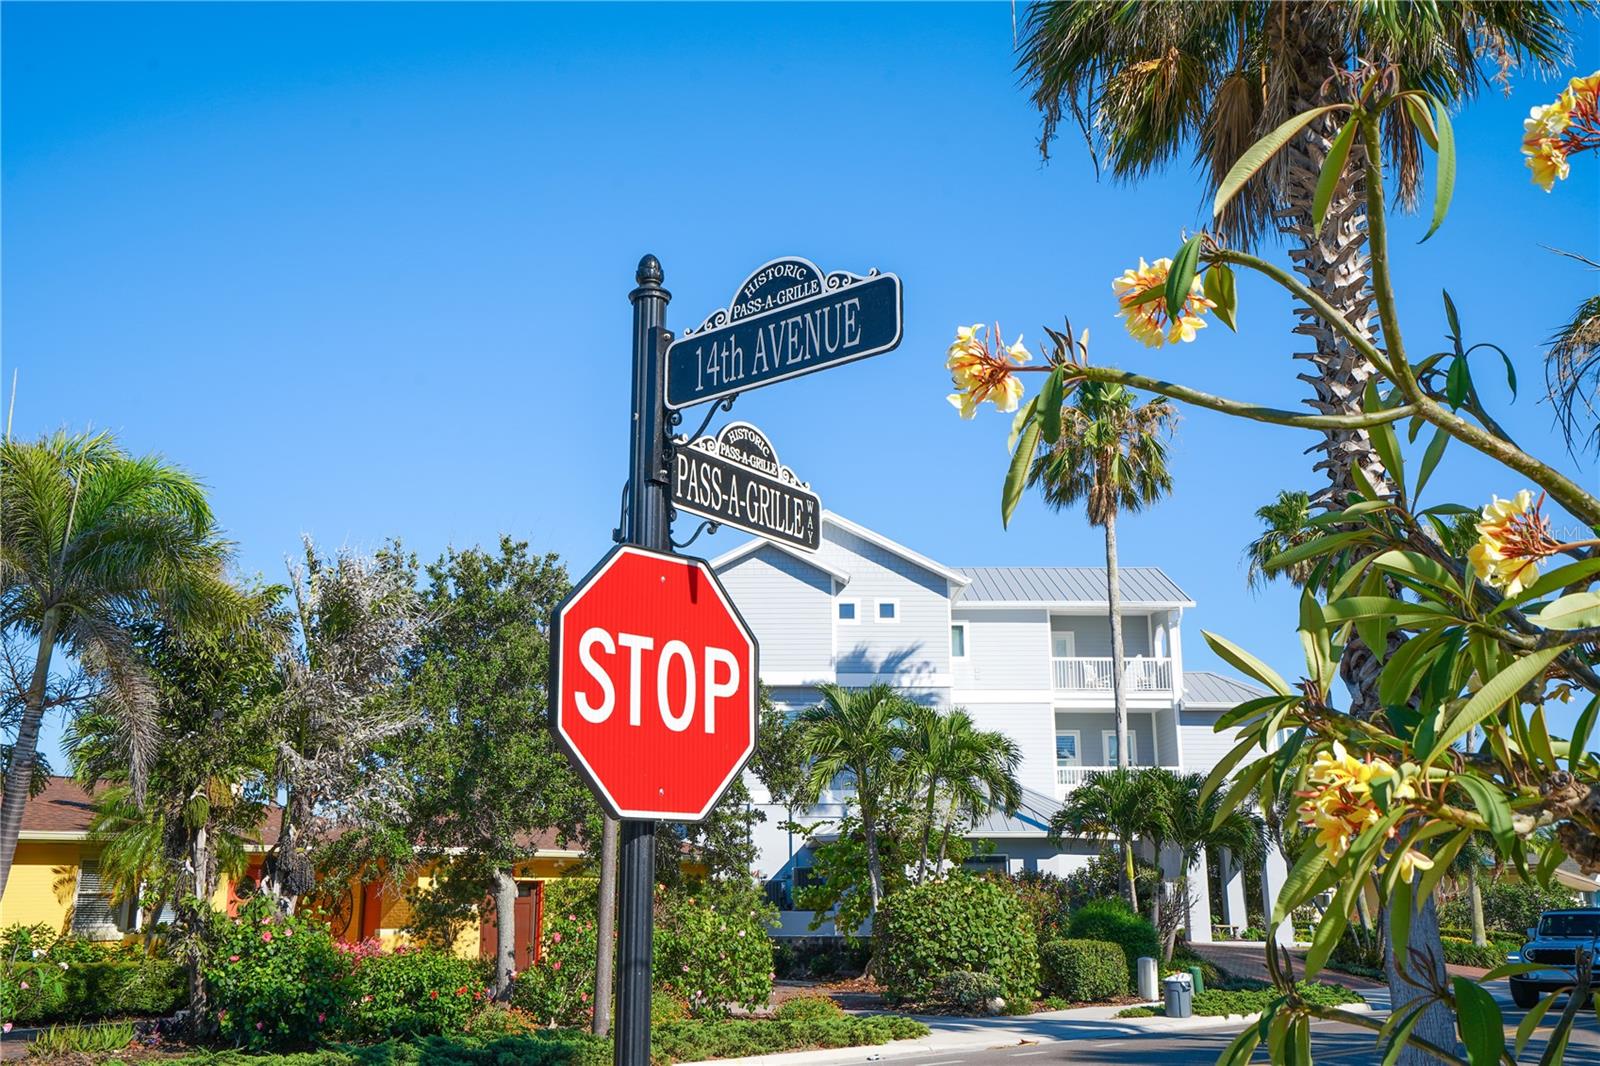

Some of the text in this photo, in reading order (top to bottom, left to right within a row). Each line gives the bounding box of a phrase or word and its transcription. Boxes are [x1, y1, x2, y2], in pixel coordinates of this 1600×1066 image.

[733, 279, 820, 320] PASS-A-GRILLE
[744, 264, 807, 299] HISTORIC
[695, 297, 862, 392] 14th AVENUE
[720, 442, 778, 476] PASS-A-GRILLE
[727, 429, 770, 457] HISTORIC
[676, 453, 815, 544] PASS-A-GRILLE WAY
[574, 627, 740, 734] STOP
